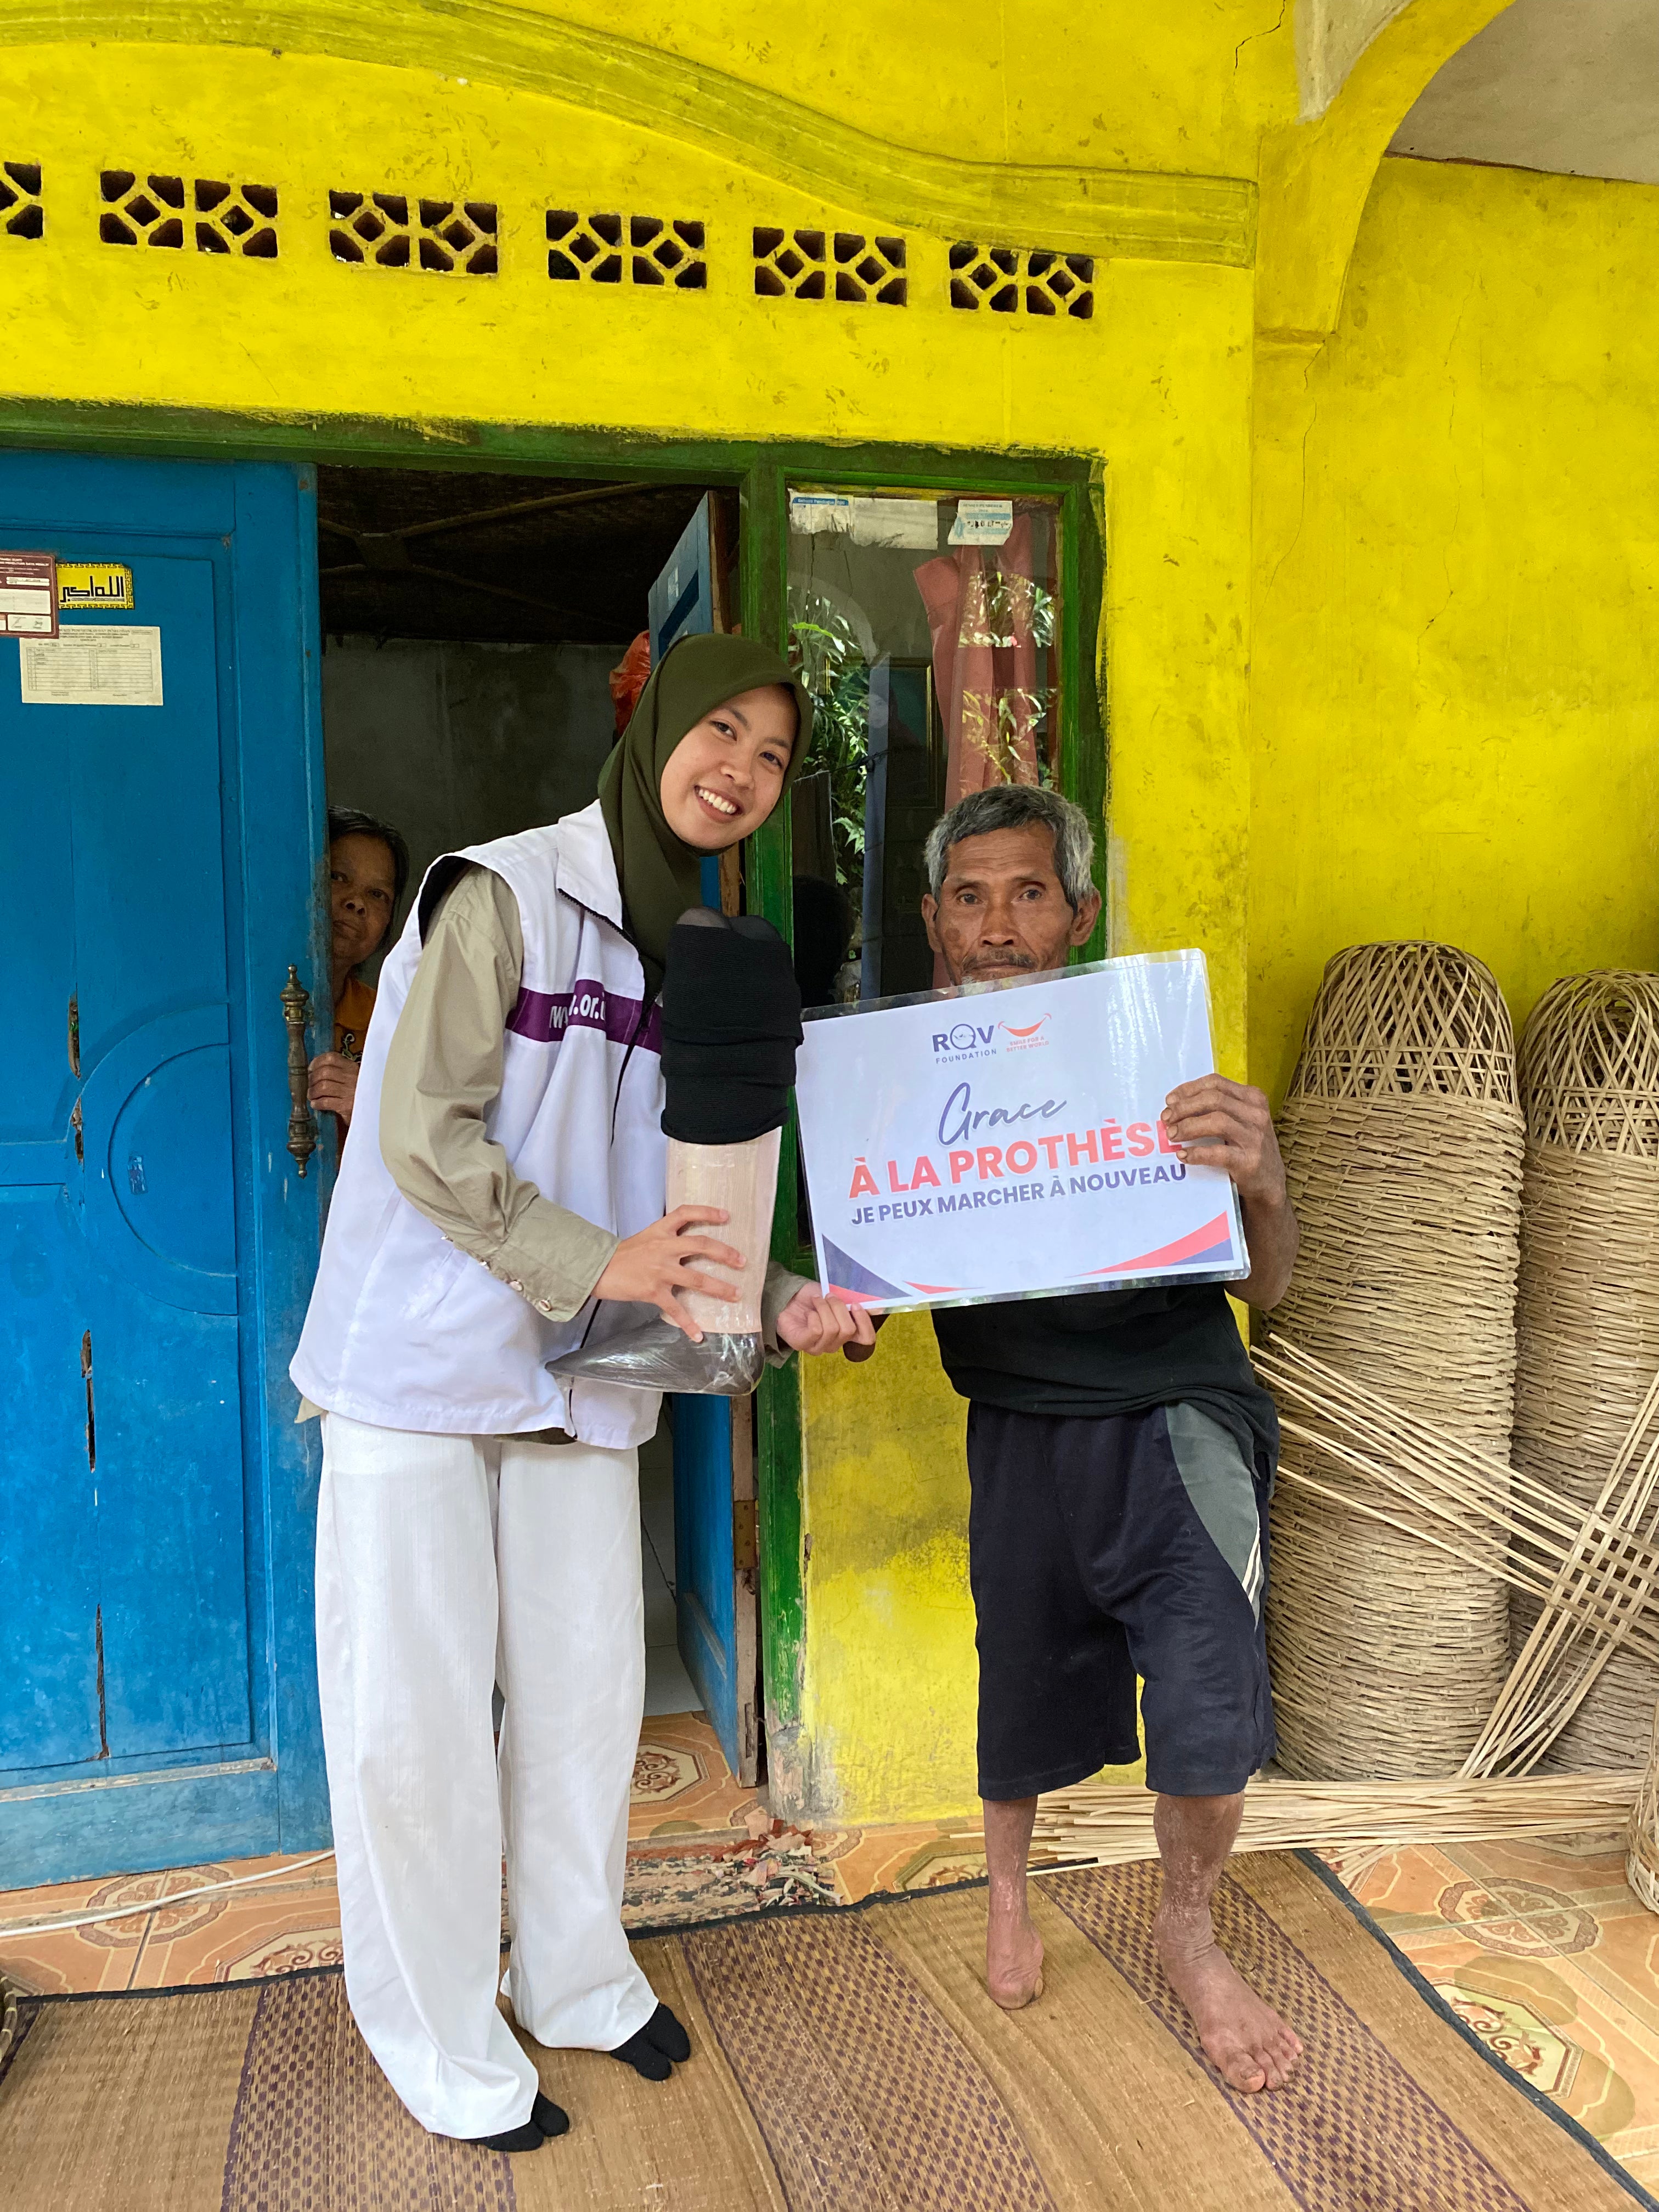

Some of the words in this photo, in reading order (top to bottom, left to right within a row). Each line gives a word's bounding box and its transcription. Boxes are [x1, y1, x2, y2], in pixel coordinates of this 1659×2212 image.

[933, 1024, 994, 1052] RQV
[936, 1048, 996, 1064] FOUNDATION
[938, 1082, 1067, 1146] Grace
[849, 1156, 881, 1198] À
[887, 1155, 941, 1193] LA
[851, 1207, 875, 1224] JE
[879, 1198, 934, 1221] PEUX
[938, 1183, 1044, 1214] MARCHER
[1050, 1175, 1066, 1197] À
[1070, 1164, 1186, 1194] NOUVEAU
